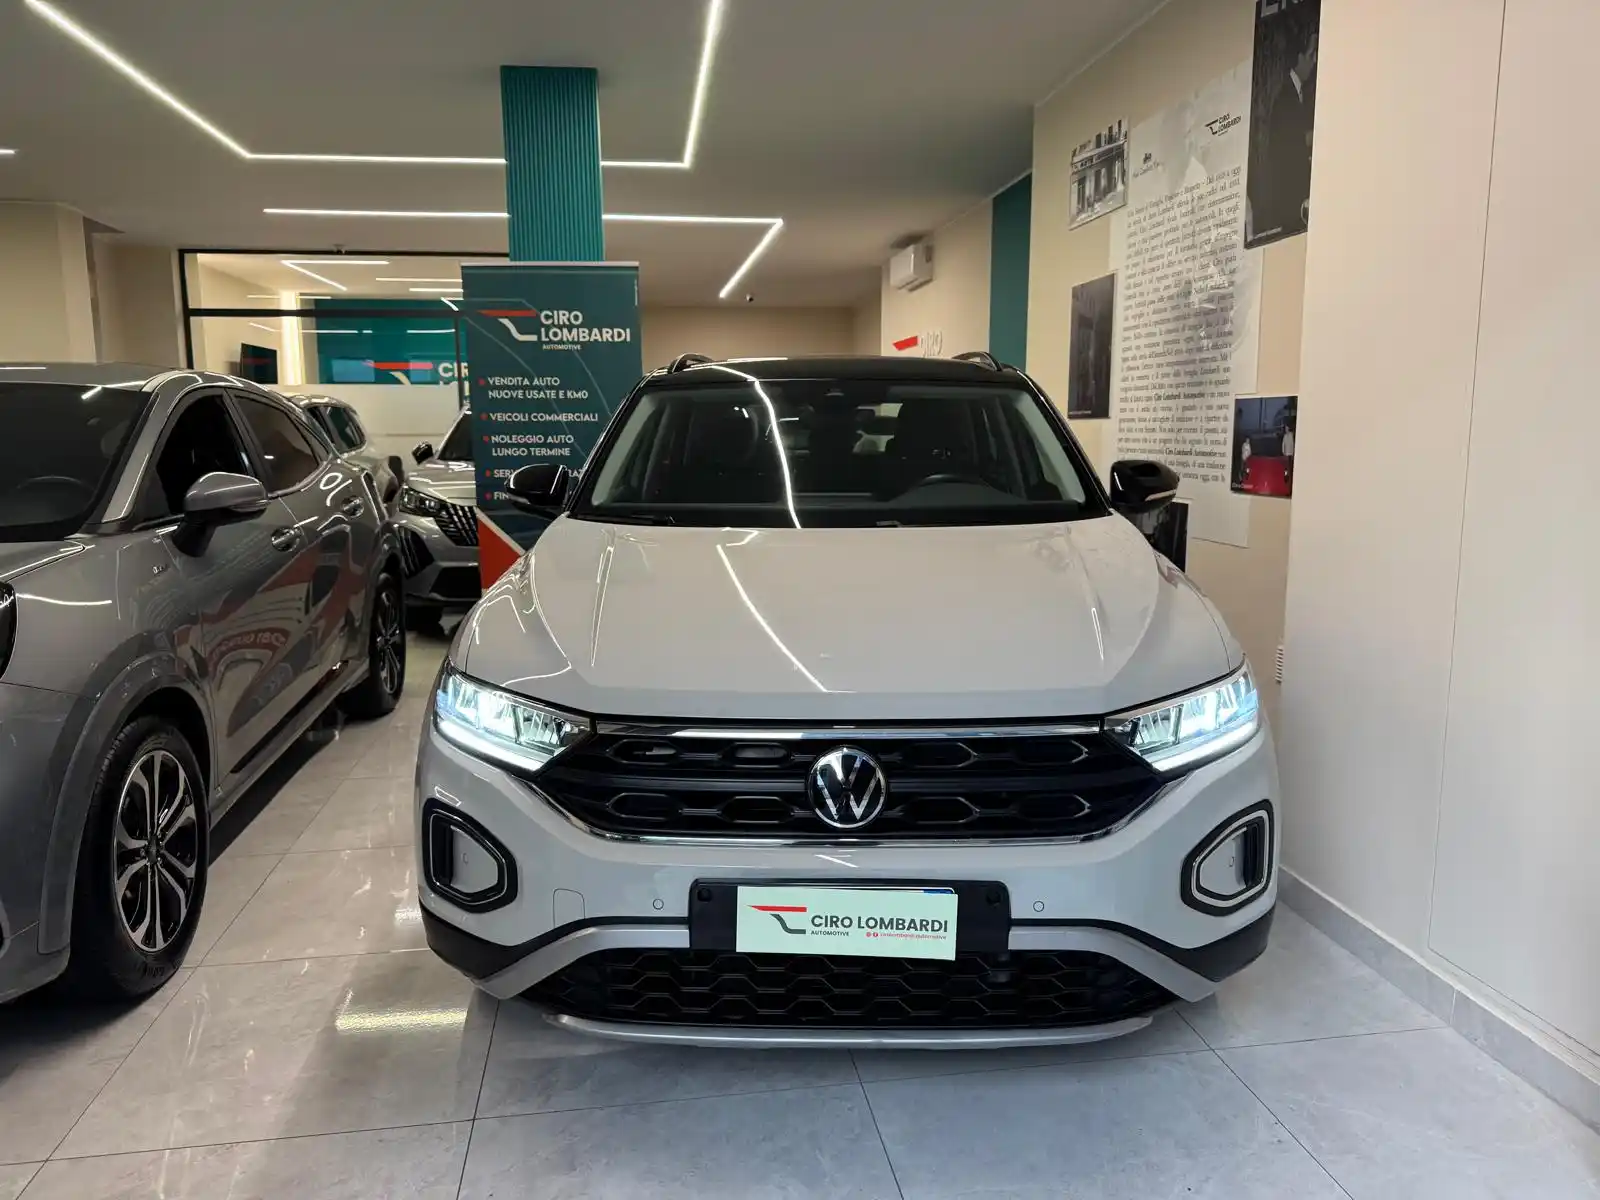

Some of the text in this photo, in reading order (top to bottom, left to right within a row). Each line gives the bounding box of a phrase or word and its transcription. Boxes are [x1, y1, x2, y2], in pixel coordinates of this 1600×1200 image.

[540, 310, 583, 325] CIRO
[540, 327, 631, 342] LOMBARDI
[437, 362, 469, 378] CIR
[487, 376, 561, 386] VENDITA AUTO
[488, 389, 524, 399] NUOVE
[525, 389, 557, 399] USATE
[558, 389, 565, 399] E
[489, 412, 598, 422] VEICOLI COMMERCIALI
[491, 434, 575, 444] NOLEGGIO AUTO
[492, 447, 571, 456] LUNGO TERMINE
[493, 491, 509, 500] FIN
[810, 914, 948, 932] CIRO LOMBARDI
